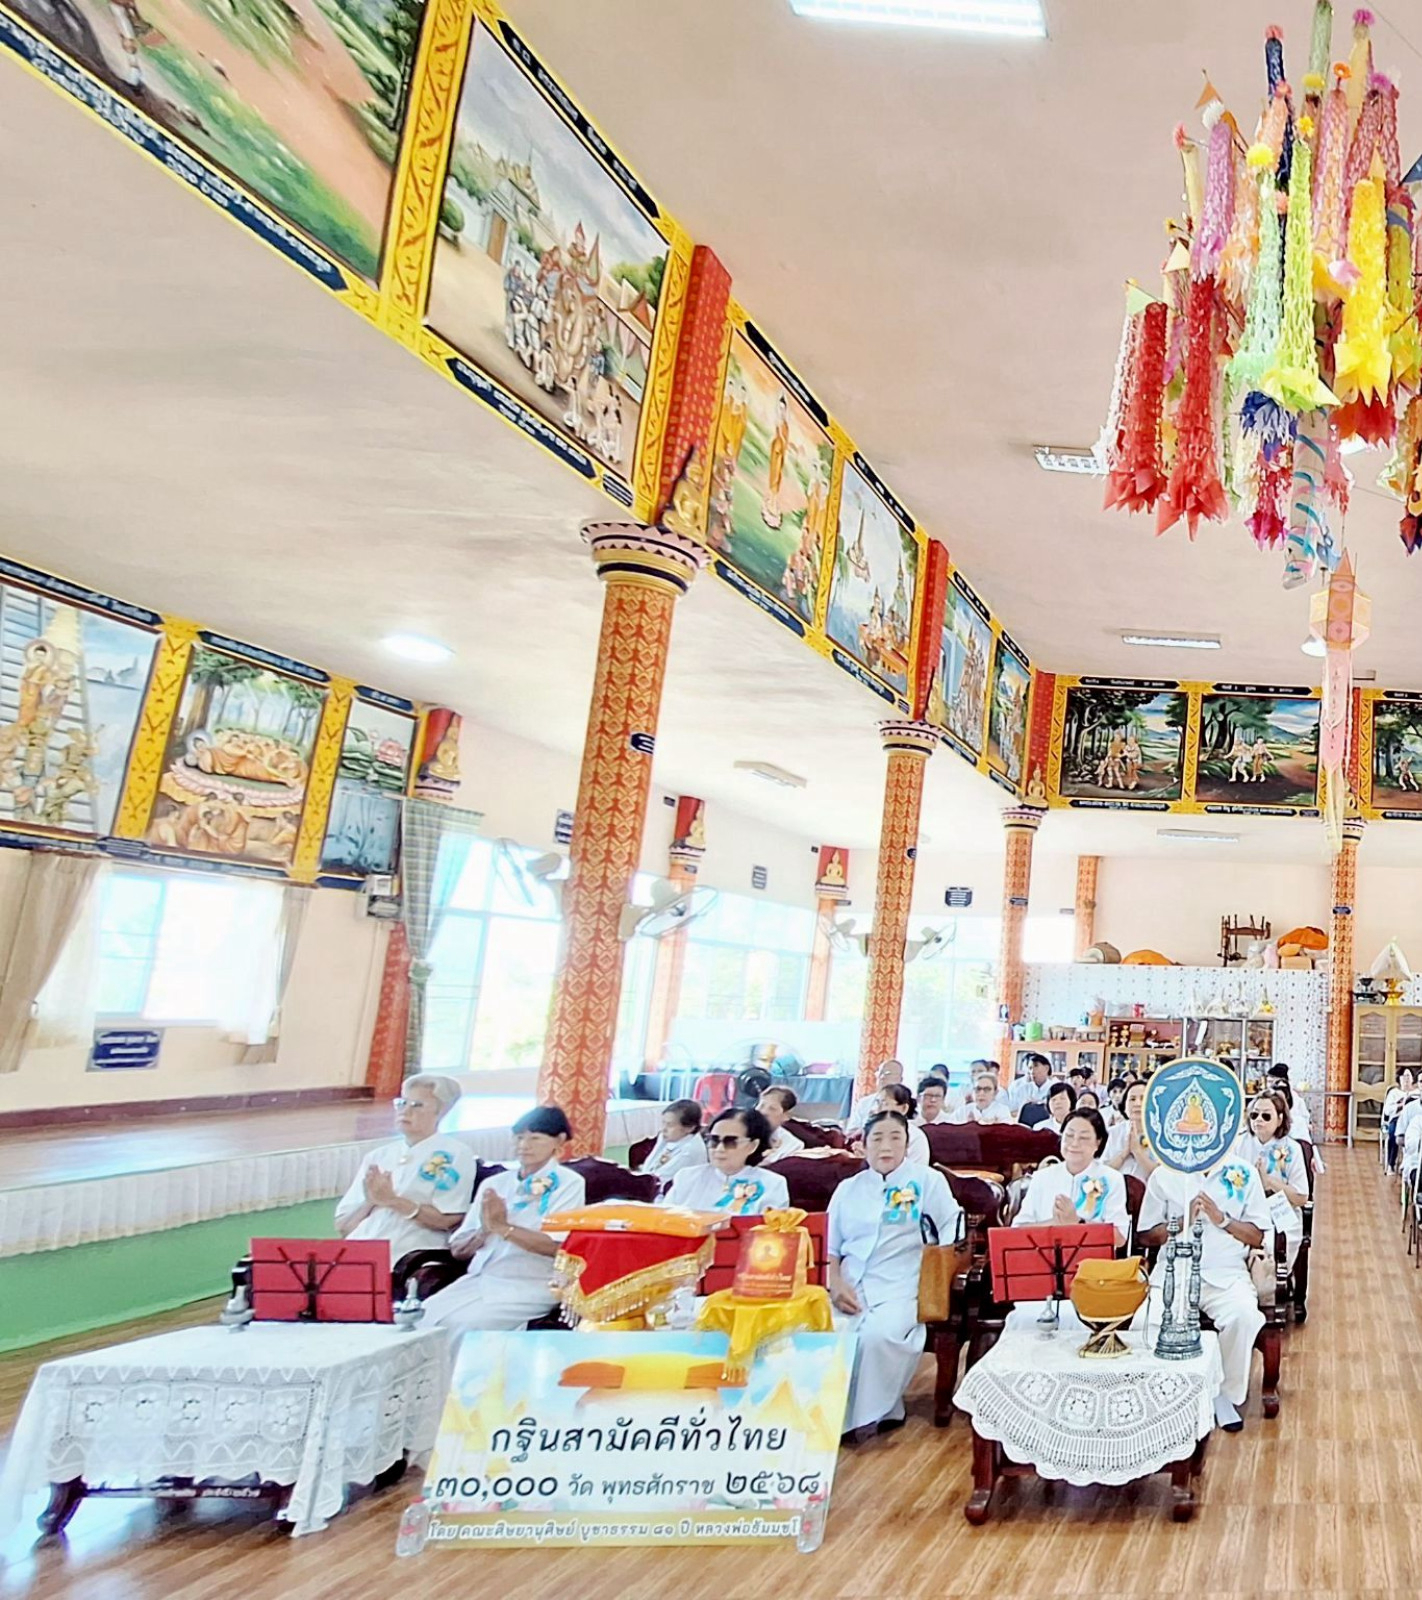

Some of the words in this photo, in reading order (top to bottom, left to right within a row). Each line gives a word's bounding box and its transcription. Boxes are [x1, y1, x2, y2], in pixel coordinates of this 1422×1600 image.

[491, 1407, 787, 1462] กฐินสามัคคีทั่วไทย
[435, 1474, 559, 1501] ๓๐,๐๐๐
[568, 1474, 594, 1496] วัด
[602, 1473, 715, 1504] พุทธศักราช
[725, 1470, 821, 1495] ๒๕๖๘
[429, 1521, 457, 1539] โดย
[680, 1519, 692, 1535] ปี
